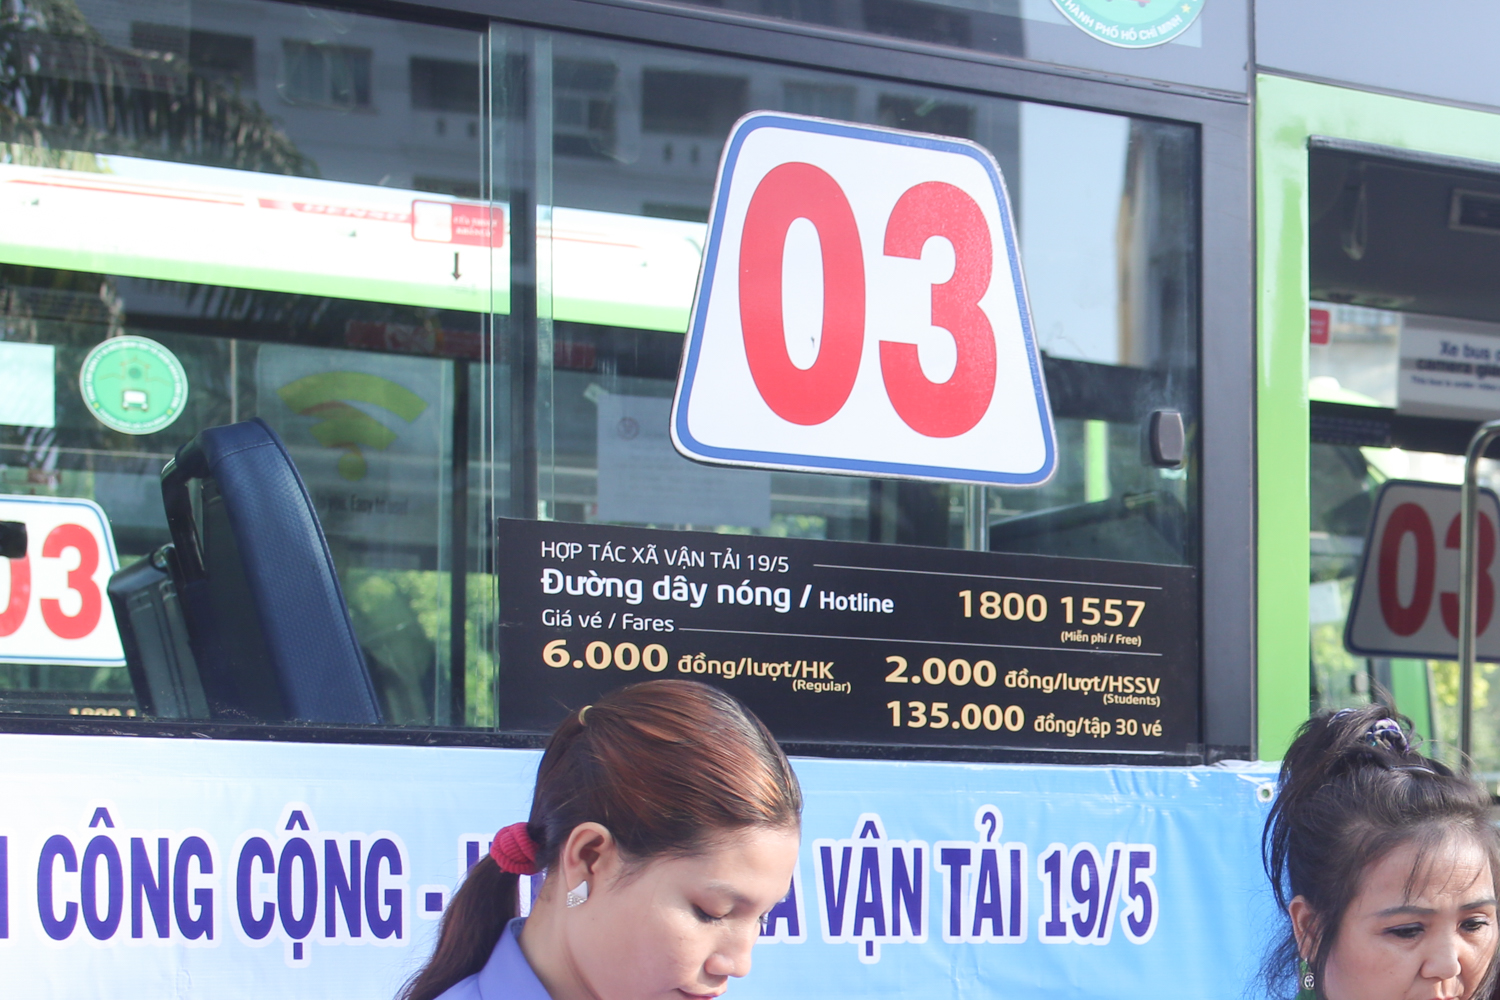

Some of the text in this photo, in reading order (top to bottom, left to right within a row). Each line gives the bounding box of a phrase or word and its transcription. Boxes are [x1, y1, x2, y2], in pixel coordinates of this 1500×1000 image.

[1157, 14, 1183, 35] MINH
[738, 161, 997, 438] 03
[1441, 341, 1458, 357] Xe
[1463, 344, 1490, 360] bus
[540, 541, 789, 573] HỢP TÁC XÃ VẬN TẢI 19/5
[1377, 501, 1496, 639] 03
[541, 568, 643, 604] Đường
[652, 574, 707, 608] dây
[717, 579, 791, 613] nóng
[819, 590, 894, 614] Hotline
[958, 589, 1146, 628] 1800 1557
[541, 608, 573, 628] Giá
[578, 611, 602, 629] vé
[622, 613, 674, 632] Fares
[1060, 630, 1089, 643] (Miễn
[1091, 631, 1107, 645] phí
[1115, 634, 1142, 647] Free)
[542, 639, 834, 681] 6.000 đồng/lượt/HK
[885, 655, 1160, 695] 2.000 đồng/lượt/HSSV
[792, 679, 852, 694] (Regular)
[1103, 693, 1161, 708] (Students)
[886, 700, 1163, 738] 135.000 đồng/tập 30 vé
[36, 806, 214, 940] CÔNG
[236, 809, 403, 960] CỘNG
[820, 820, 923, 957] VẬN
[940, 811, 1020, 937] TẢI
[1044, 849, 1152, 938] 19/5
